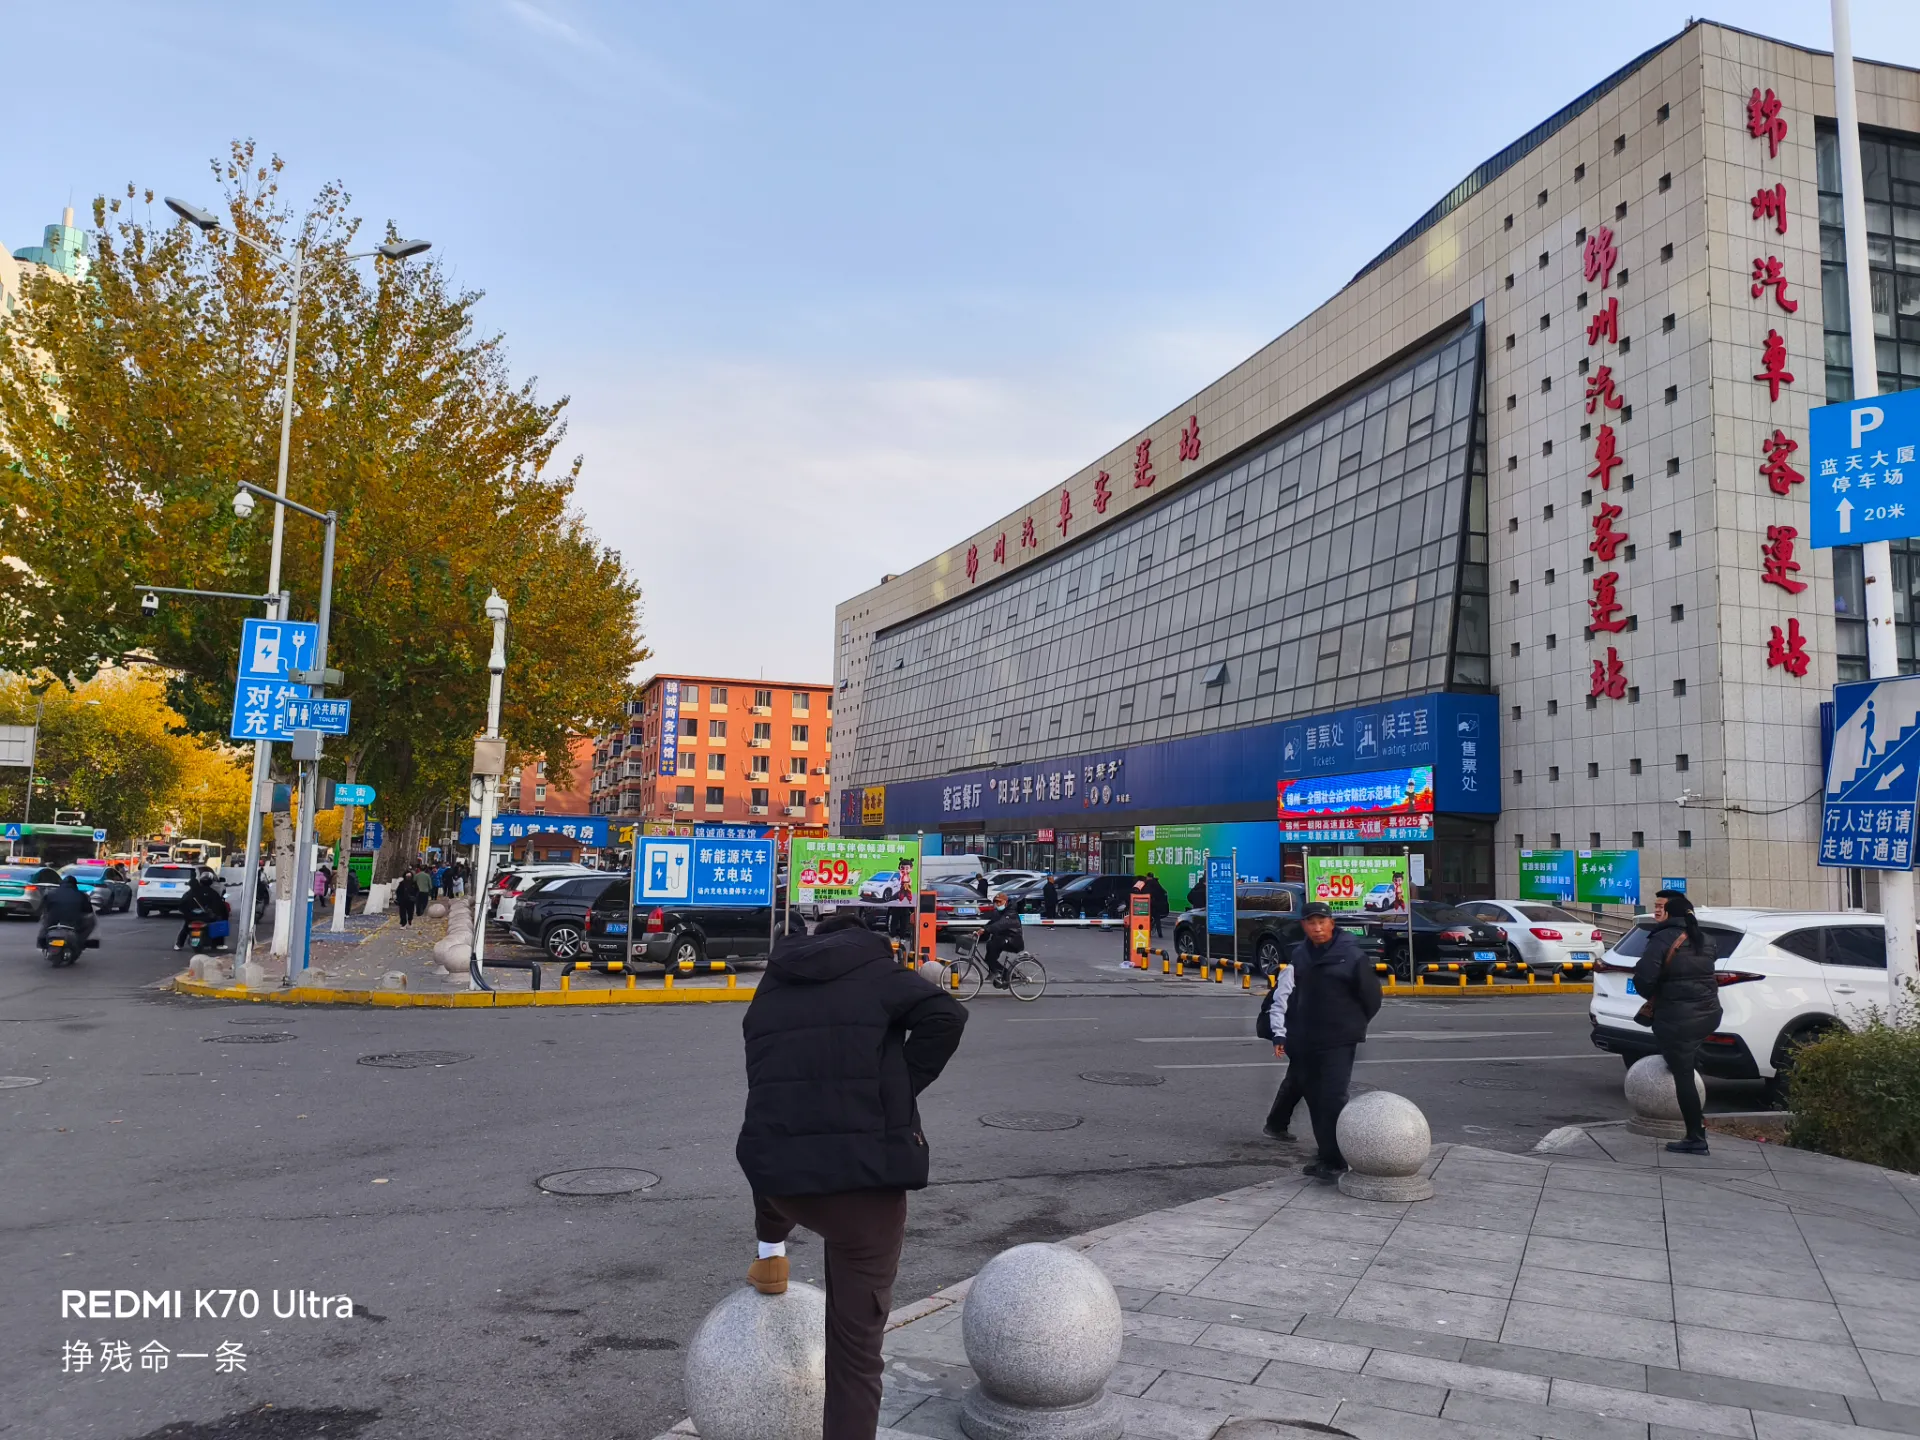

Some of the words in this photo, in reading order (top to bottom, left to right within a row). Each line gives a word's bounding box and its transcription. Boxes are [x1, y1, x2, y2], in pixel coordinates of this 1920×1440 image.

[1851, 406, 1885, 449] P
[1820, 444, 1916, 476] 蓝天大厦
[1832, 468, 1904, 494] 停车场
[1864, 502, 1906, 522] 20米
[312, 703, 347, 717] 公共厕所
[663, 682, 679, 759] 锦诚商务宾馆
[1305, 722, 1345, 751] 售票处
[1381, 708, 1429, 742] 候车室
[1312, 755, 1336, 767] Tickets
[1381, 744, 1406, 757] waiting
[1409, 741, 1430, 752] room
[1460, 741, 1478, 792] 售票处
[943, 783, 982, 812] 客运餐厅
[998, 769, 1076, 805] 阳光平价超市
[1826, 808, 1912, 834] 行人过街请
[700, 848, 767, 864] 新能源汽车
[1822, 835, 1909, 863] 走地下通道
[713, 866, 753, 882] 充电站
[818, 859, 849, 885] 59
[1330, 875, 1354, 897] 59
